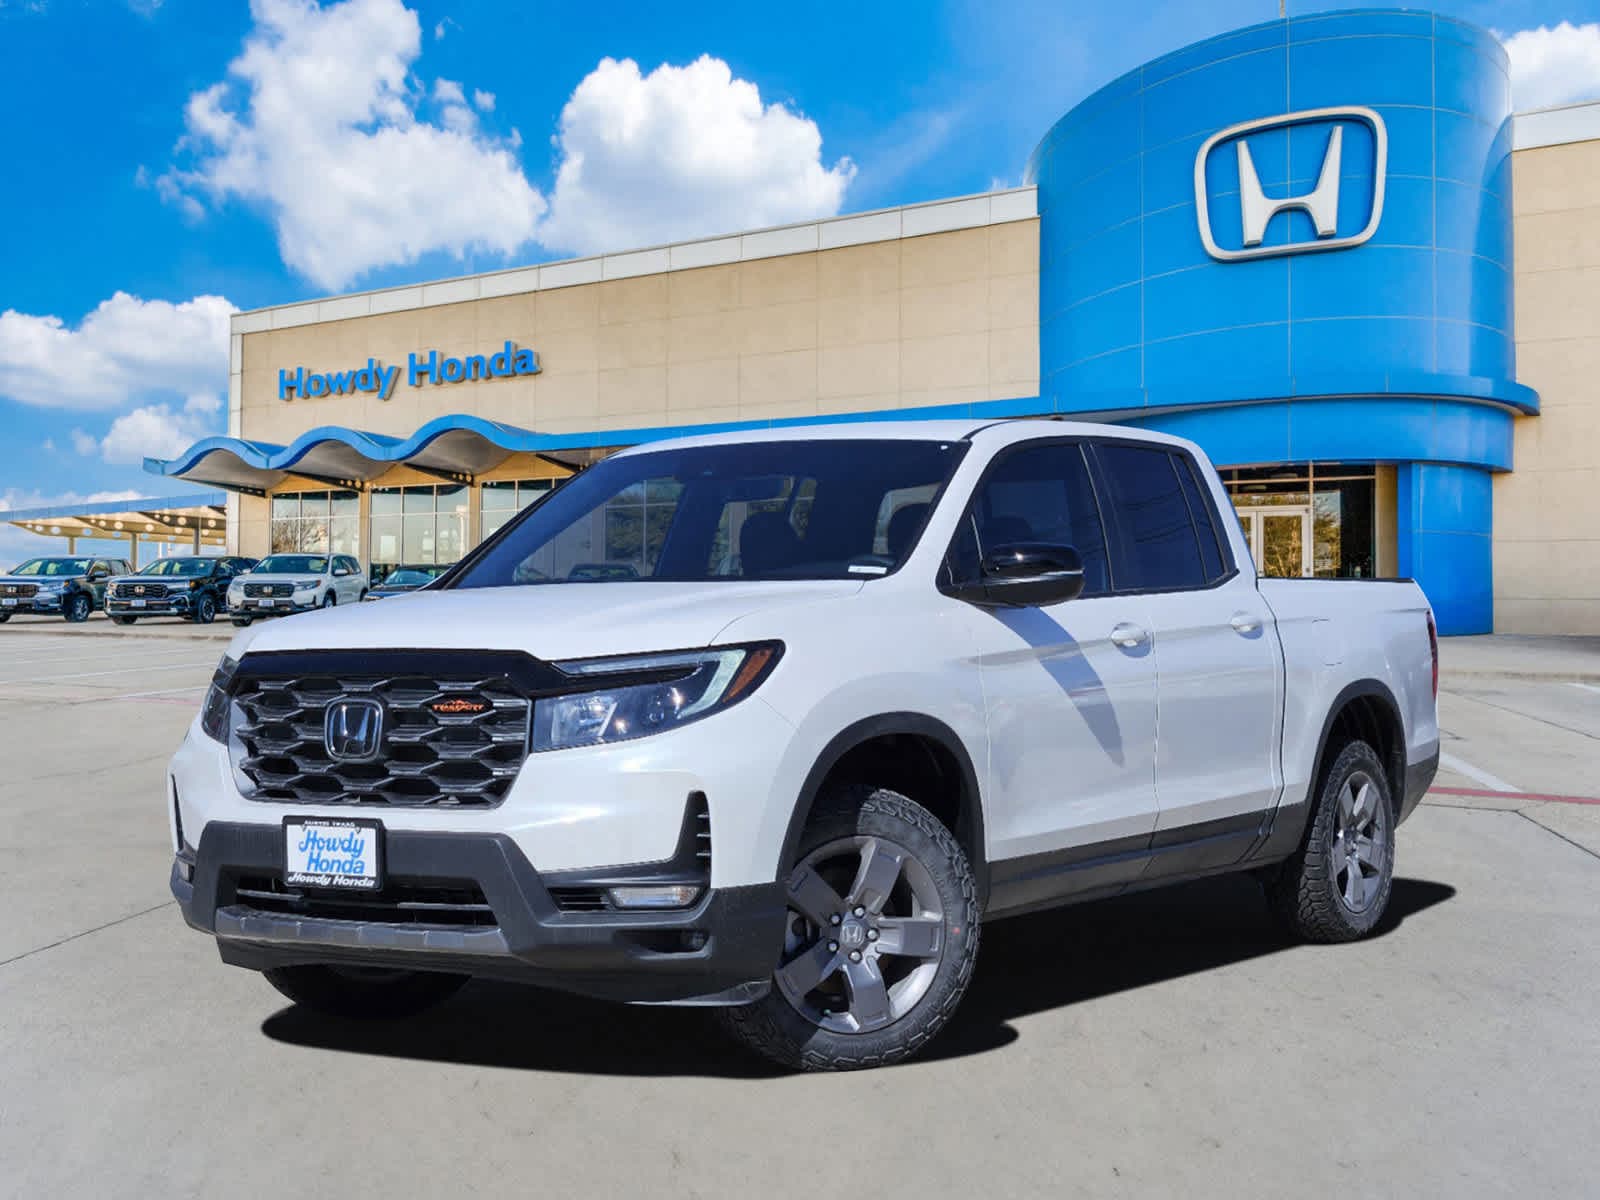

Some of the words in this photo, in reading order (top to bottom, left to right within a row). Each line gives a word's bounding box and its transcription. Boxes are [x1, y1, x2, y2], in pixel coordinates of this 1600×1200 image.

[279, 358, 400, 401] Howdy
[408, 340, 541, 387] Honda
[298, 830, 365, 858] Howdy
[306, 850, 365, 874] Honda
[288, 872, 331, 886] Howdy
[333, 875, 375, 887] Honda
